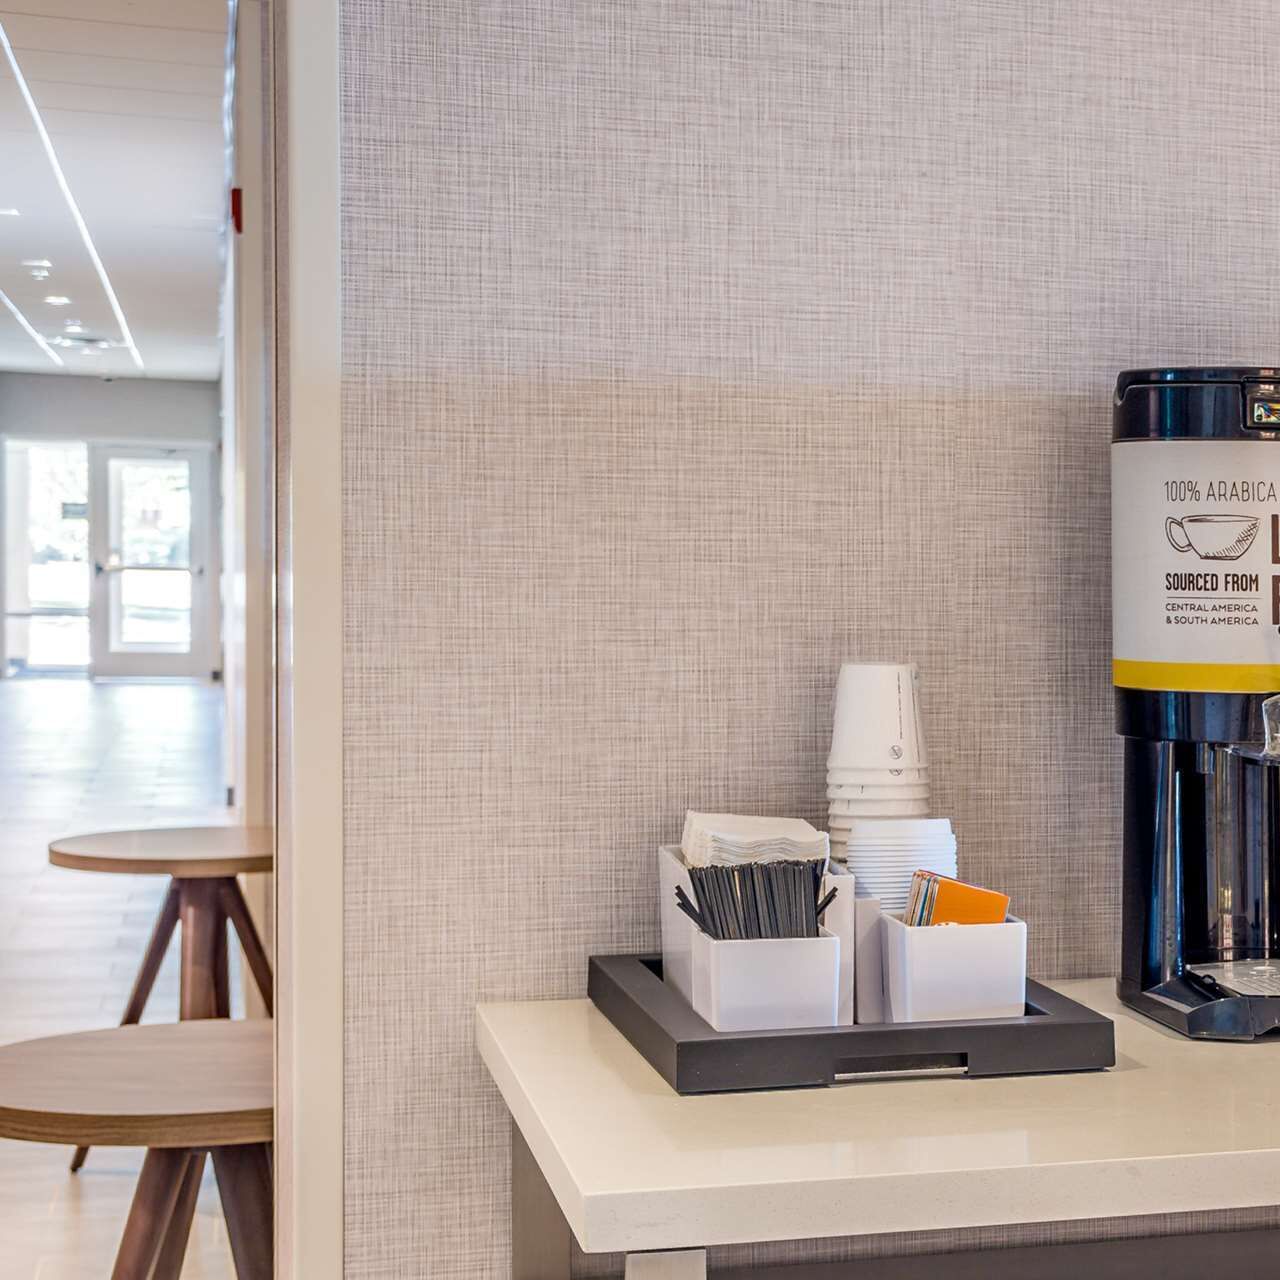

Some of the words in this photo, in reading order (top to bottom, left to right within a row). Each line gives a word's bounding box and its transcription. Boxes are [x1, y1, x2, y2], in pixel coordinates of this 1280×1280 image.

[1164, 480, 1201, 502] 100%
[1206, 480, 1278, 502] ARABICA
[1165, 572, 1219, 592] SOURCED
[1224, 573, 1260, 592] FROM
[1165, 602, 1209, 613] CENTRAL
[1210, 603, 1259, 614] AMERICA
[1165, 615, 1173, 625] &
[1174, 615, 1208, 625] SOUTH
[1210, 616, 1260, 626] AMERICA
